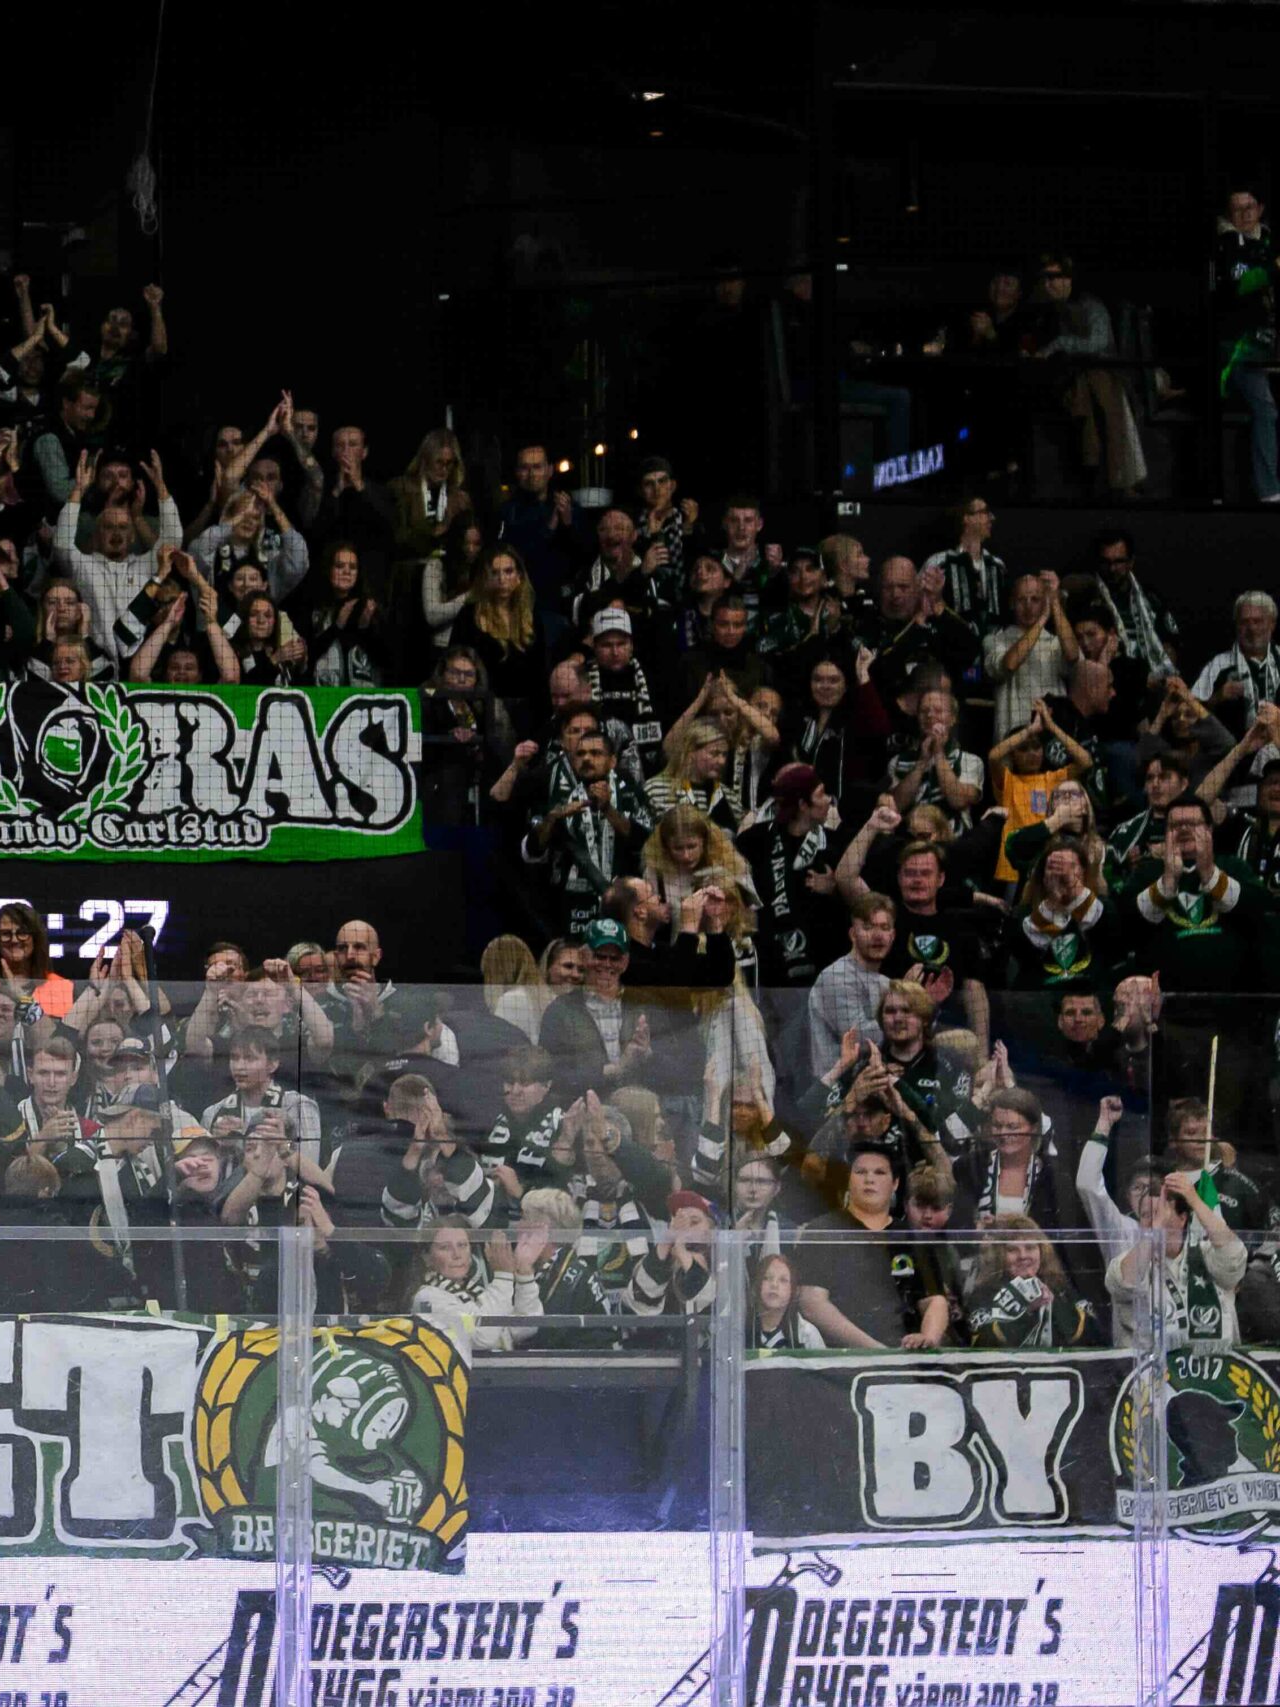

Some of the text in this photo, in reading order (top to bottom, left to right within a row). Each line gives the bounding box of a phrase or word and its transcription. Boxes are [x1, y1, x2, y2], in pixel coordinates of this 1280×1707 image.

[91, 811, 267, 847] Carlstad
[1175, 1356, 1224, 1381] 2017
[863, 1376, 1072, 1520] BY
[1120, 1482, 1239, 1519] BGERIETS
